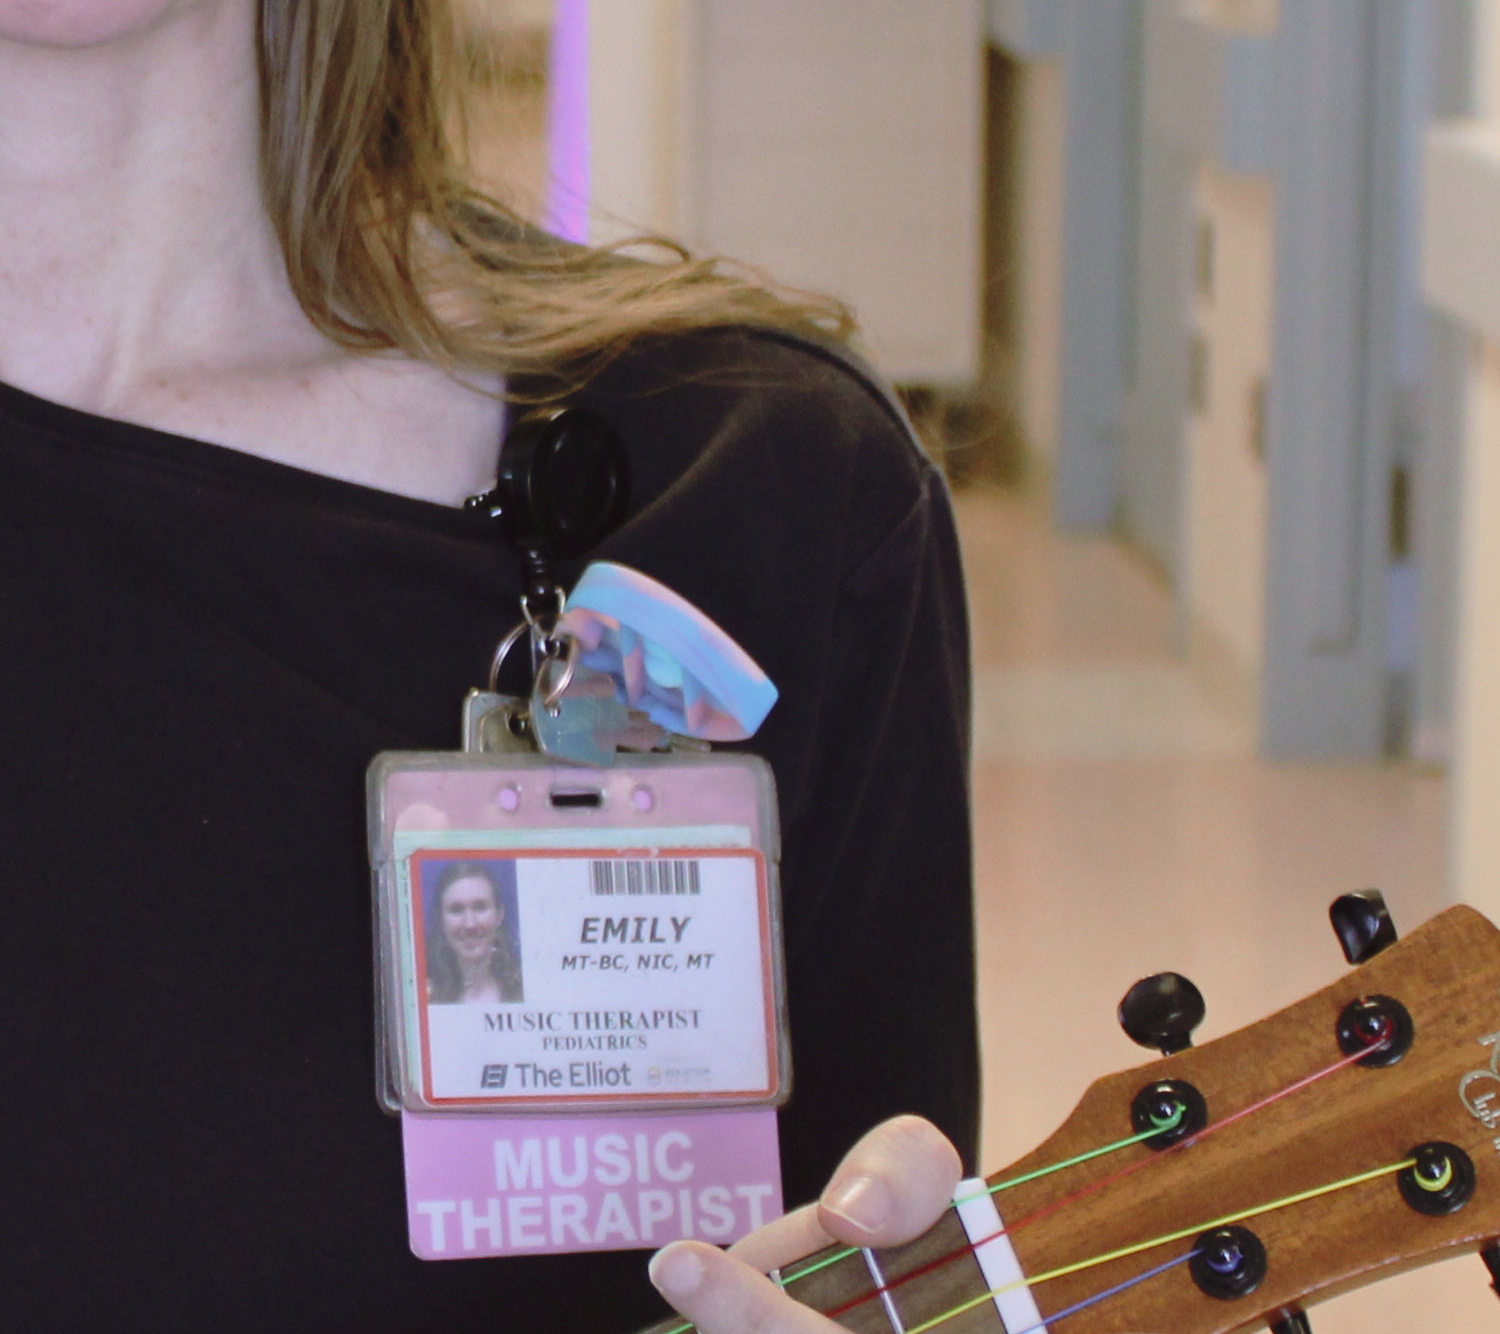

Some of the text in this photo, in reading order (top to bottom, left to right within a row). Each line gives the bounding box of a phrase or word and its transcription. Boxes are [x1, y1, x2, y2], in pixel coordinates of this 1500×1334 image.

[580, 916, 692, 944] EMILY
[561, 952, 715, 973] MT-BC, NIC, MT
[483, 1009, 704, 1033] MUSIC THERAPIST
[542, 1034, 648, 1052] PEDIATRICS
[514, 1061, 632, 1088] The Elliot
[493, 1131, 695, 1193] MUSIC
[416, 1183, 774, 1253] THERAPIST
